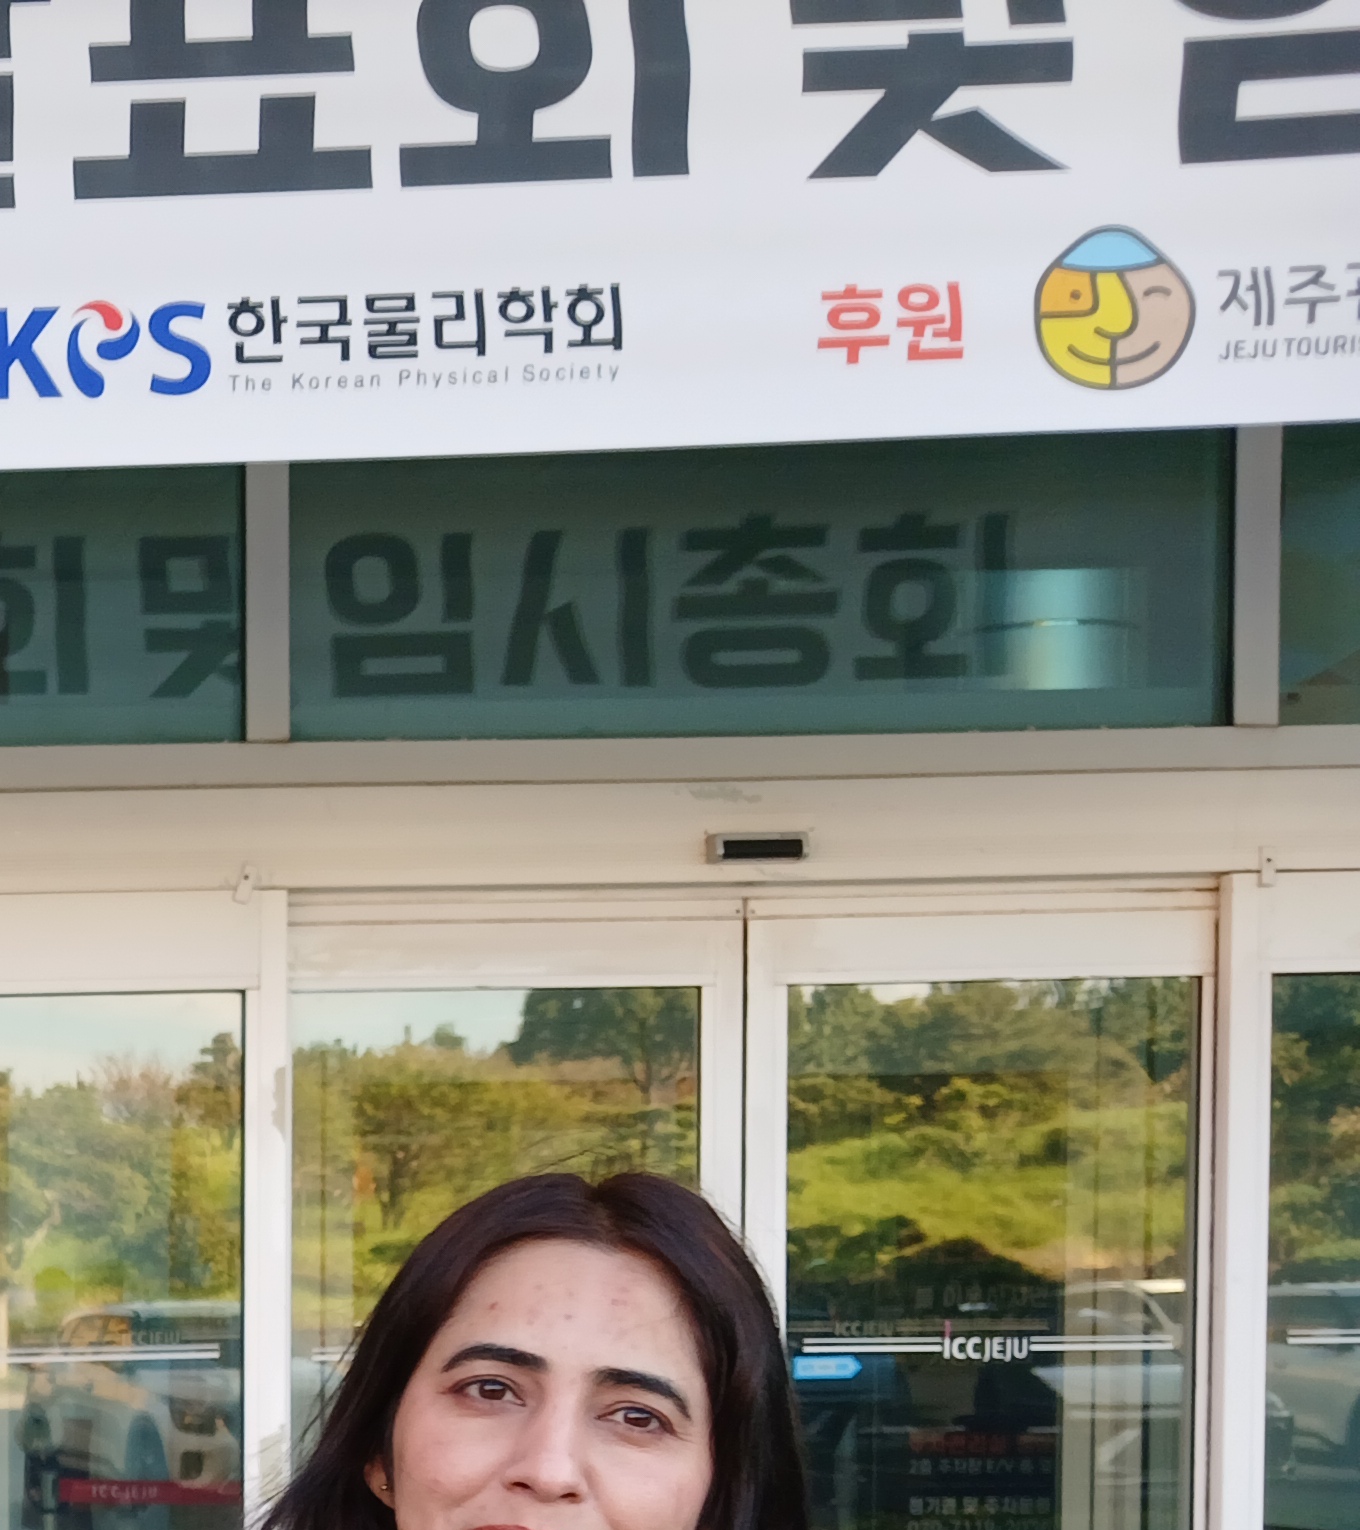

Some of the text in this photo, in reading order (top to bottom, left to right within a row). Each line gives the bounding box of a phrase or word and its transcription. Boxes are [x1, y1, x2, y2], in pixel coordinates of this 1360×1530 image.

[226, 283, 623, 364] 한국물리학회
[818, 283, 964, 364] 후원
[1219, 334, 1360, 361] JEJU TOURI
[228, 362, 621, 392] The Korean Physical Society
[323, 512, 1015, 698] 임시총회
